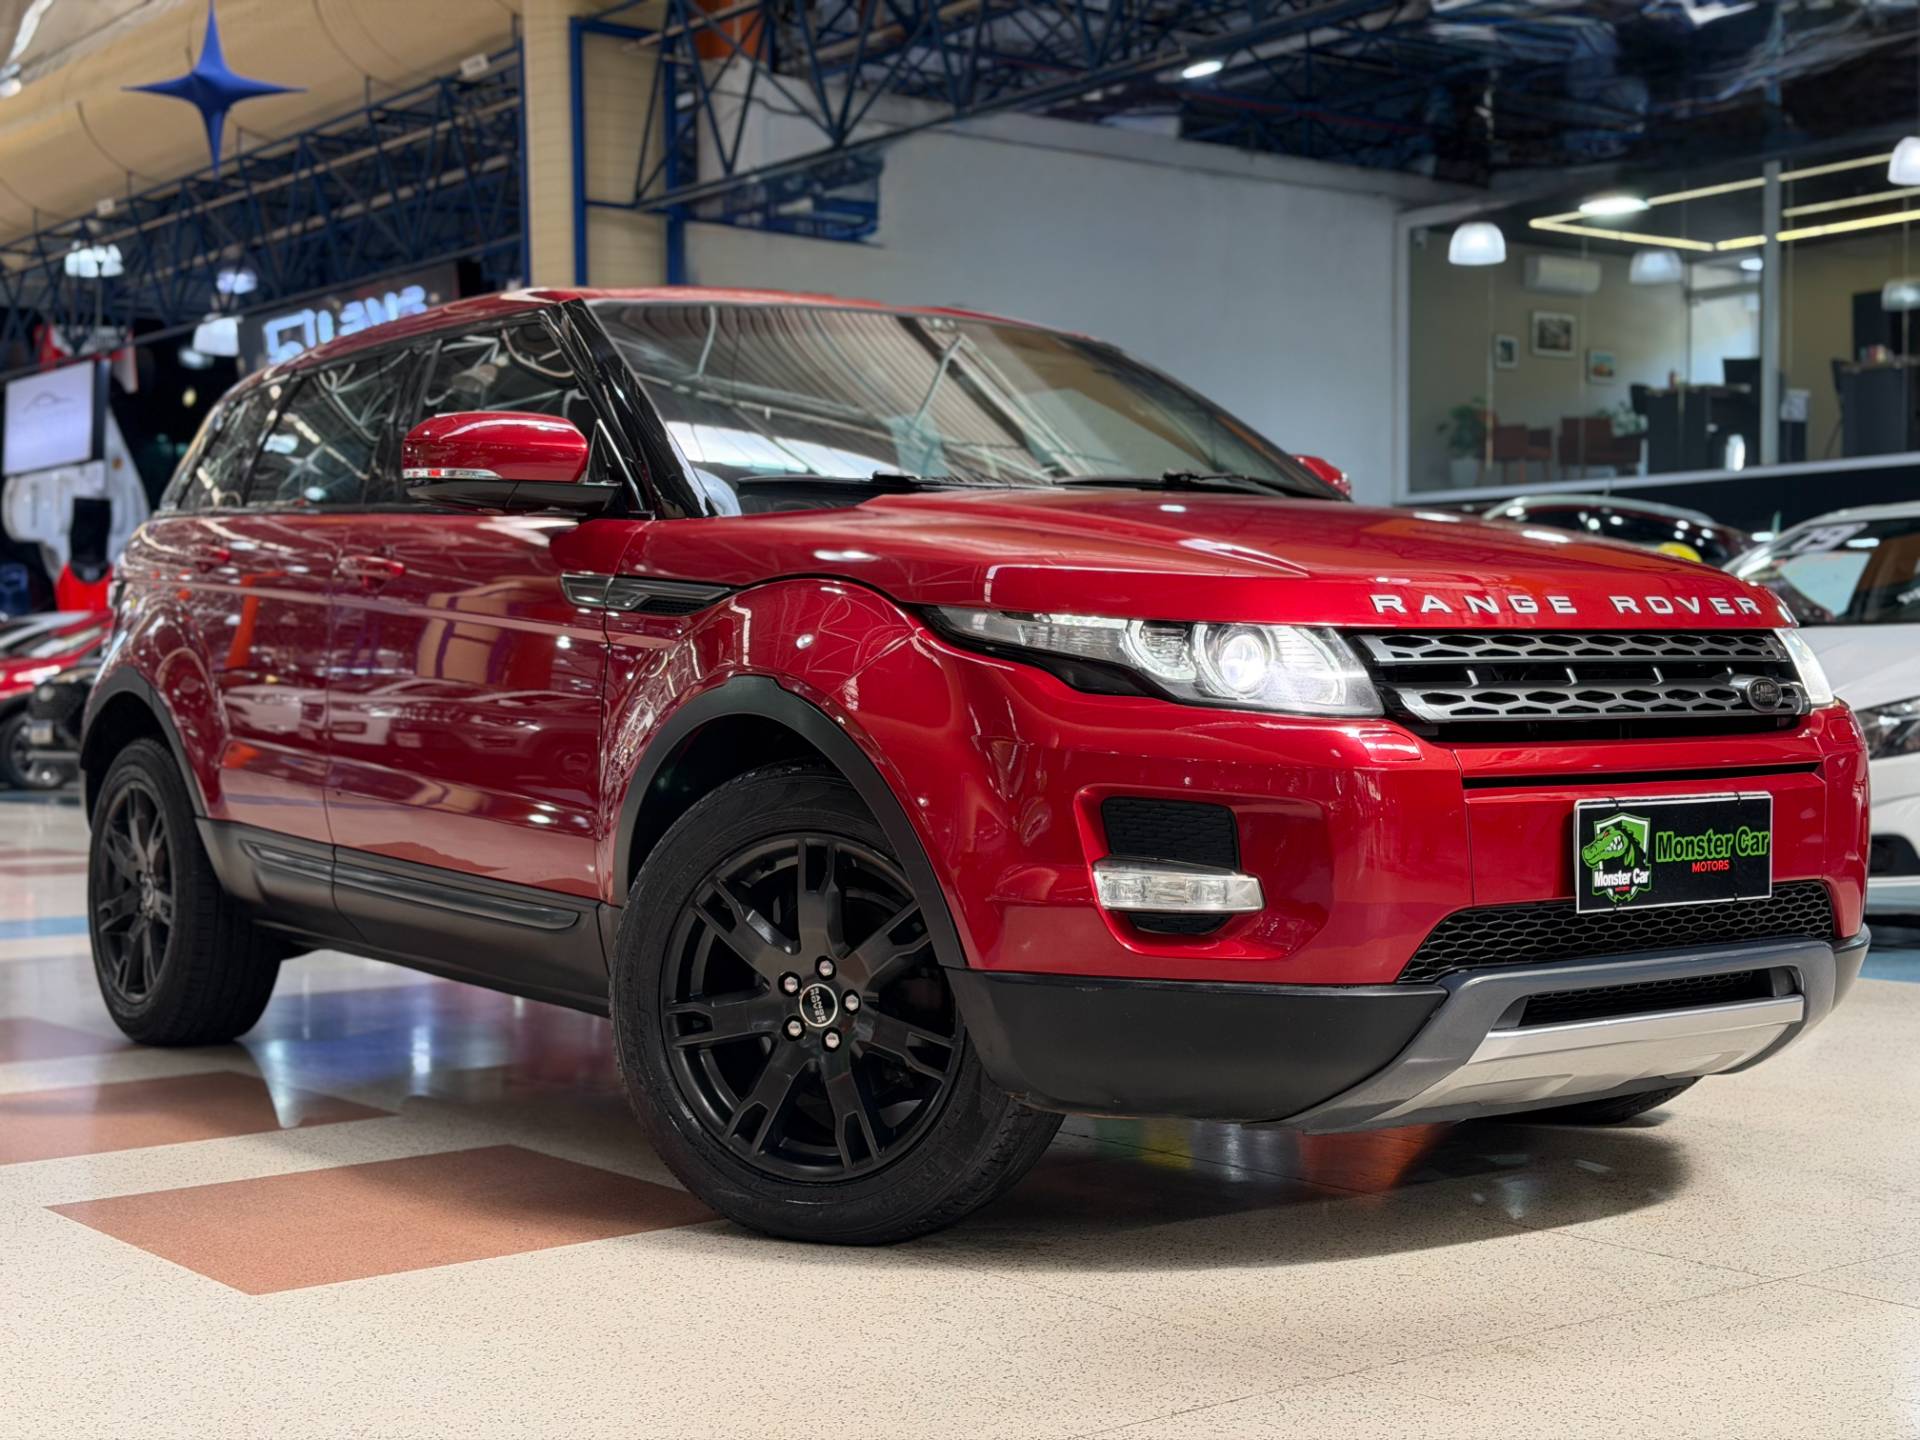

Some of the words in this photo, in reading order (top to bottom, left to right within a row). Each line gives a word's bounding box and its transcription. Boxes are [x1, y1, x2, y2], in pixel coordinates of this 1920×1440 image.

[1370, 594, 1577, 614] RANGE
[1610, 595, 1763, 615] ROVER
[1655, 828, 1734, 862] Monster
[1736, 826, 1769, 857] Car
[1691, 860, 1730, 873] MOTORS
[1594, 869, 1632, 887] Monster
[1633, 868, 1650, 884] Car
